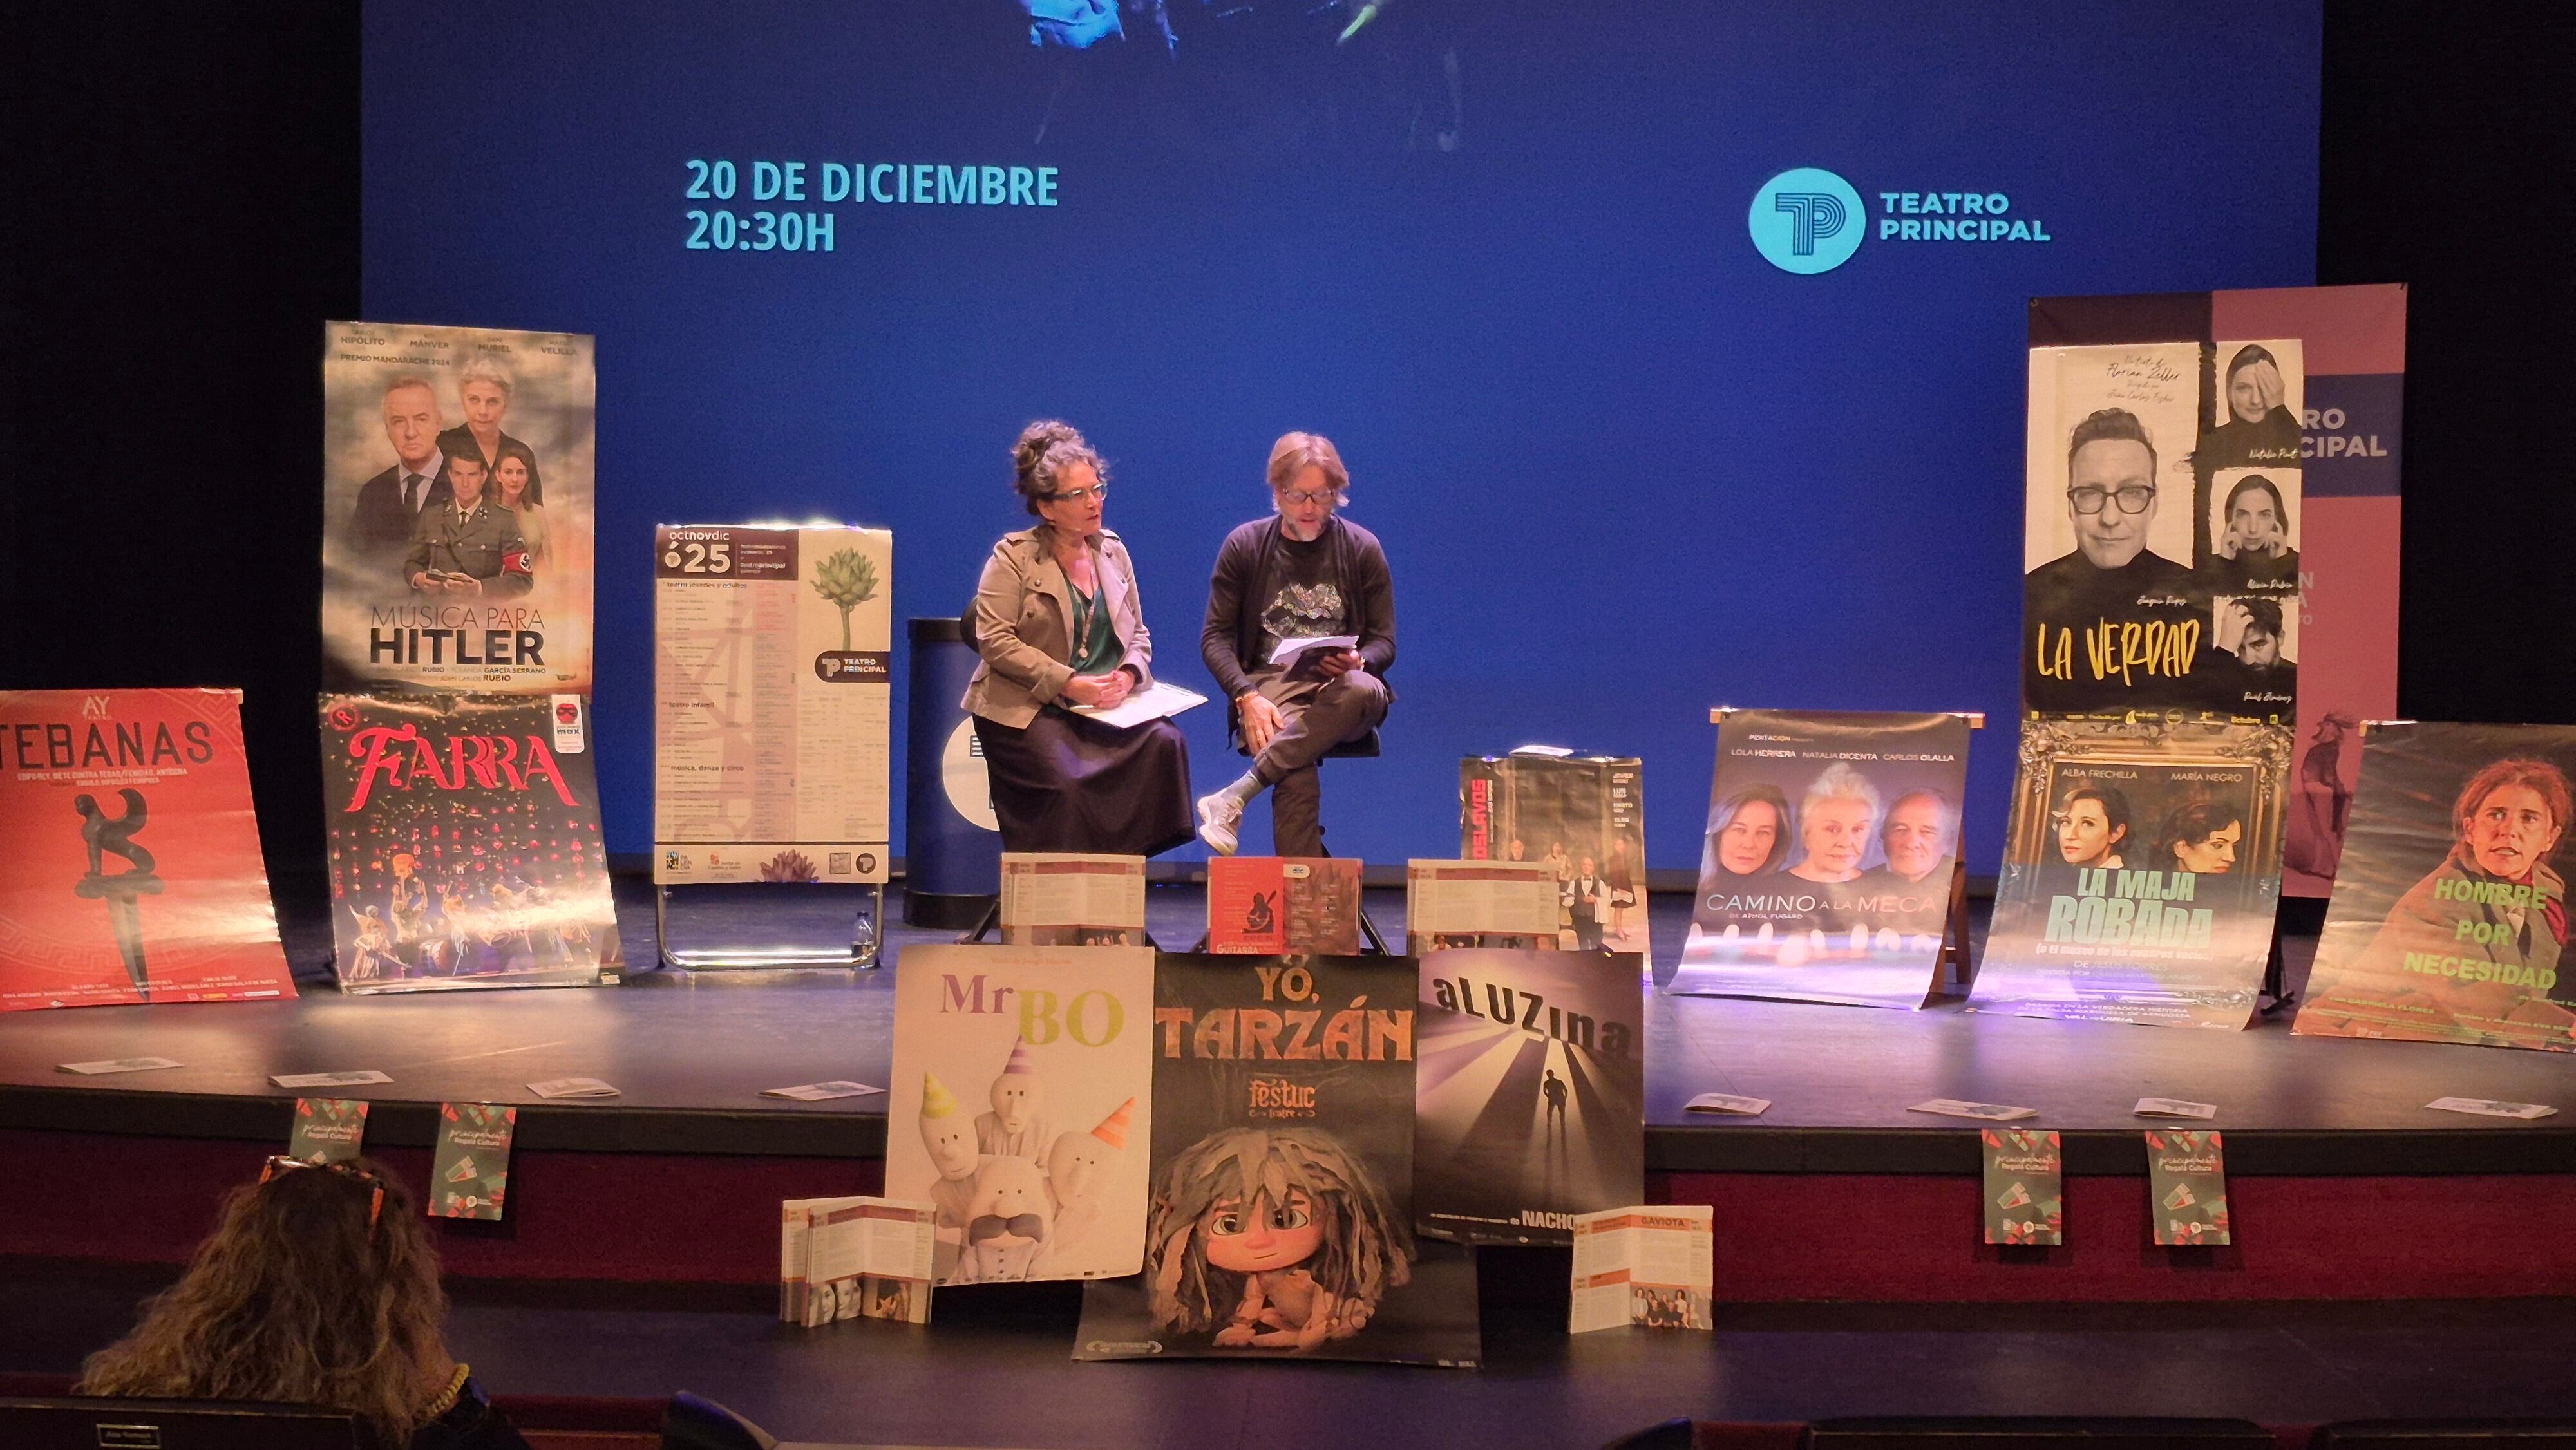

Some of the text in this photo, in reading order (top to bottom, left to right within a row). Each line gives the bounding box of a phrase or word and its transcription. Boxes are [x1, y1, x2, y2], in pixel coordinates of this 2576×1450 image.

[685, 160, 1058, 205] 20 DE DICIEMBRE
[1880, 193, 2010, 214] TEATRO
[685, 211, 835, 251] 20:30H
[1880, 220, 2051, 241] PRINCIPAL
[341, 354, 372, 362] PREMIO
[478, 344, 512, 353] MURIEL
[541, 347, 578, 356] VELILLA
[2147, 366, 2179, 382] Zeller
[370, 603, 545, 630] MÚSICA PARA
[370, 628, 545, 666] HITLER
[2038, 616, 2200, 687] LA VERDAD
[82, 696, 111, 715] AY
[1754, 749, 1797, 758] HERRERA
[1839, 752, 1878, 760] DICENTA
[344, 723, 580, 813] FARRA
[2061, 768, 2243, 782] ALBA FRECHILLA MARÍA NEGRO
[1472, 779, 1488, 860] OSLAVOS
[2077, 867, 2195, 901] LA MAJA
[2434, 878, 2550, 910] HOMBRE
[1706, 894, 1815, 912] CAMINO
[1833, 901, 1852, 909] LA
[1857, 896, 1937, 912] MECA
[2045, 894, 2213, 948] ROBADA
[2455, 920, 2512, 946] POR
[2060, 946, 2095, 956] museo
[2097, 946, 2110, 955] de
[2112, 947, 2128, 957] los
[2130, 948, 2174, 958] cuadros
[2074, 960, 2089, 968] DE
[2403, 952, 2557, 990] NECESIDAD
[1255, 966, 1320, 1004] YO,
[938, 974, 1124, 1047] Mr BO
[2348, 999, 2395, 1010] GABRIELA
[2398, 1004, 2435, 1014] FLORES
[1155, 995, 1413, 1061] TARZÁN
[1641, 1216, 1685, 1227] GAVIOTA
